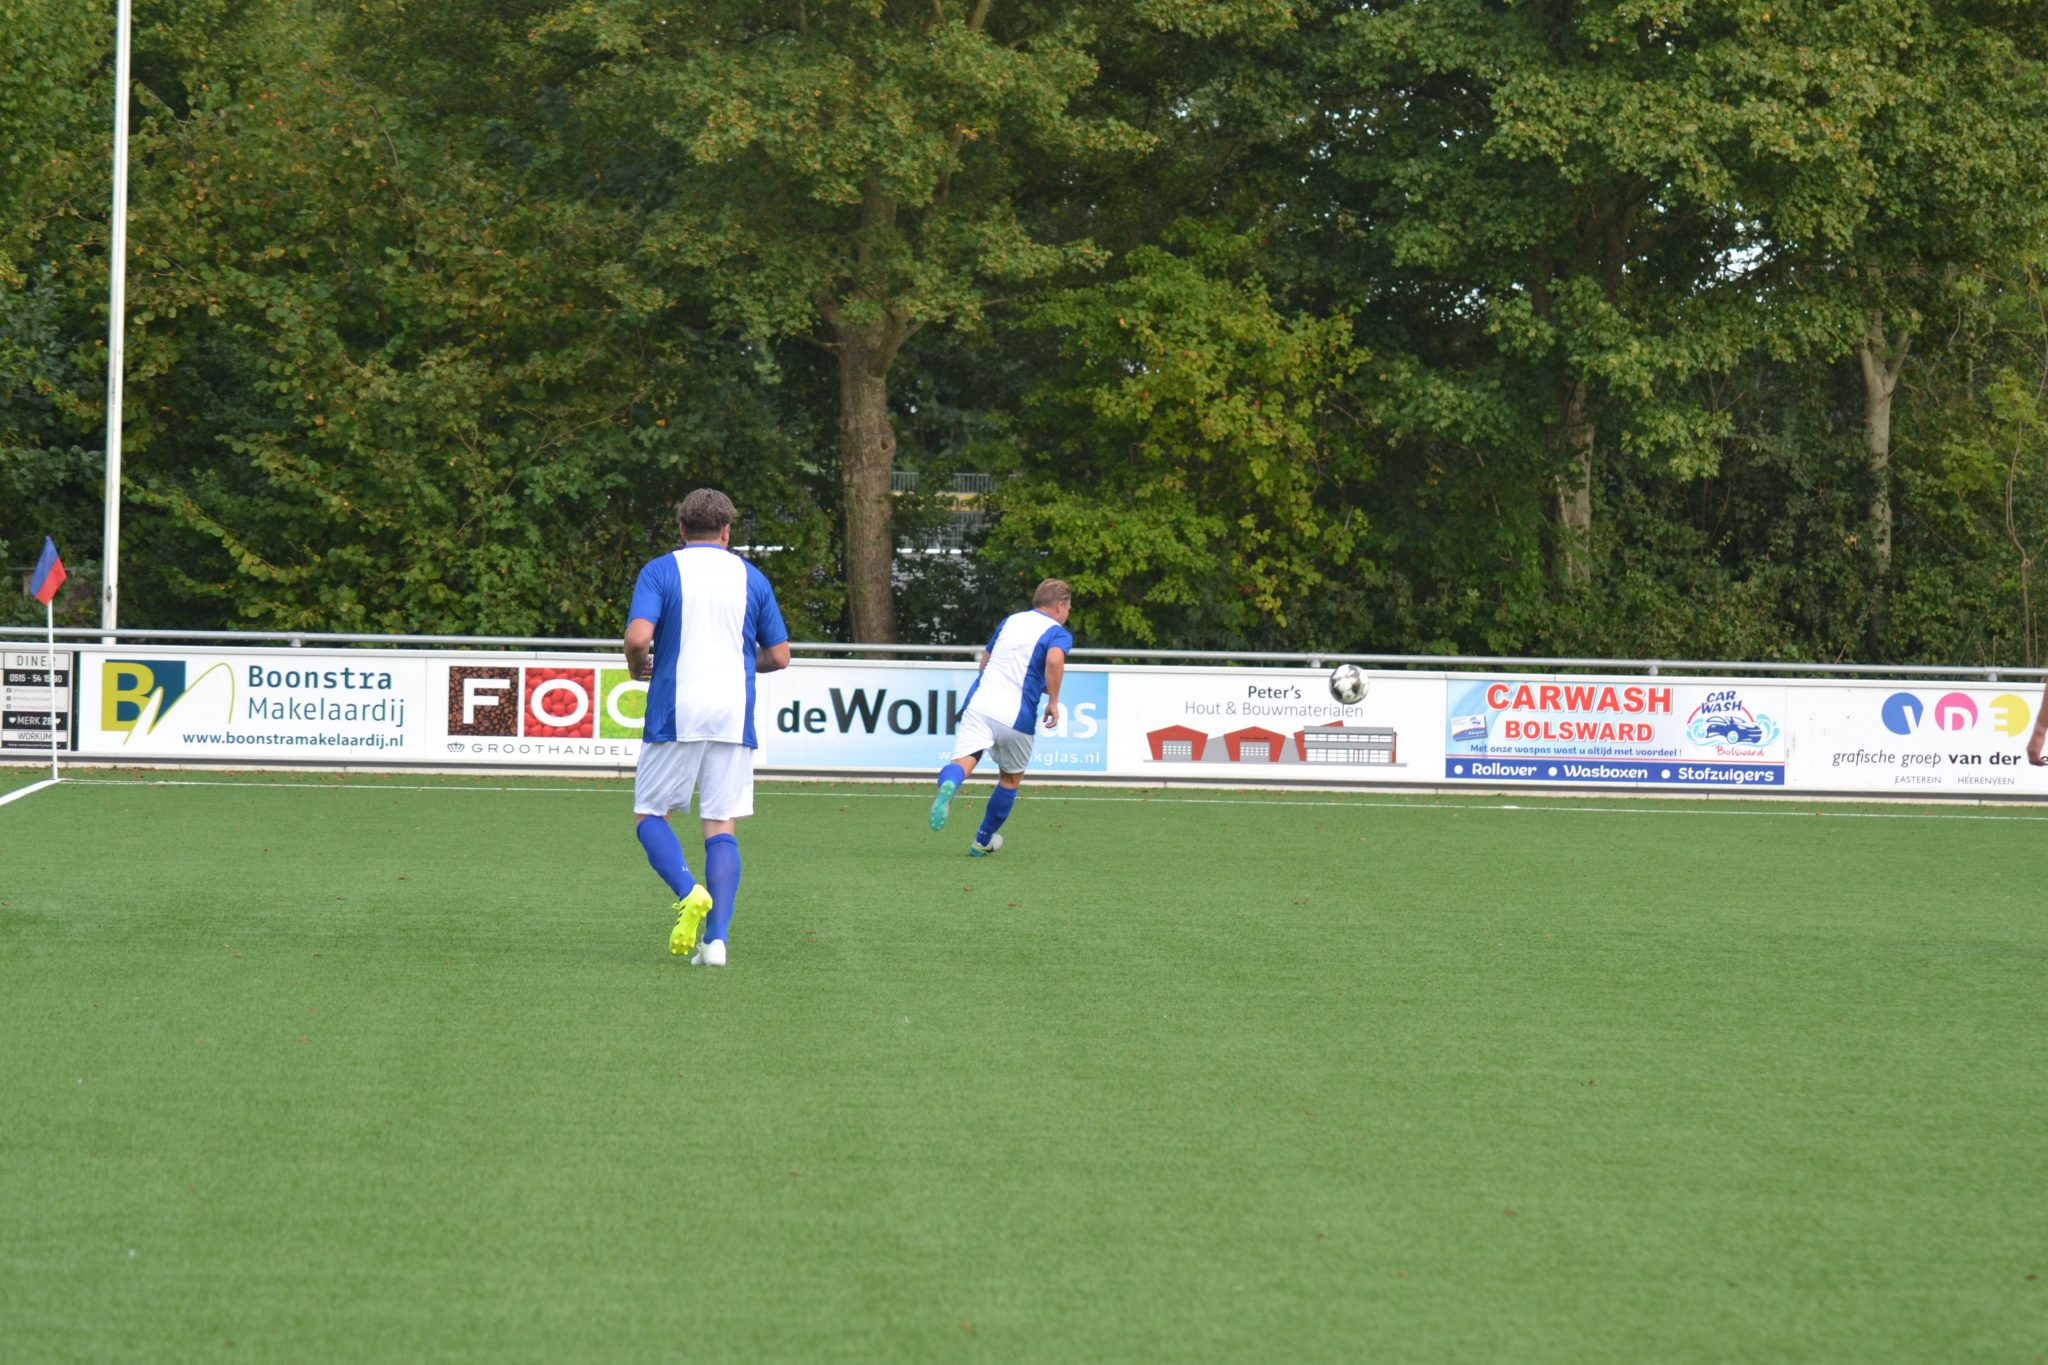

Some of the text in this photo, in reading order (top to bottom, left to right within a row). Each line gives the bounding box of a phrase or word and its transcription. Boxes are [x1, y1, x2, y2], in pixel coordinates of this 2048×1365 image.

[248, 665, 392, 690] Boonstra
[1248, 685, 1301, 700] Peter's
[1486, 684, 1673, 714] CARWASH
[1707, 691, 1736, 704] CAR
[248, 697, 405, 728] Makelaardij
[1185, 701, 1363, 717] Hout & Bouwmaterialen
[1701, 700, 1742, 714] WASH
[17, 716, 41, 725] MERK
[1504, 719, 1655, 744] BOLSWARD
[183, 731, 404, 749] www.boonstramakelaardij.nl
[472, 743, 633, 756] GROOTHANDEL
[1471, 744, 1489, 754] Met
[1490, 746, 1513, 754] onze
[1515, 746, 1551, 757] waspas
[1553, 746, 1577, 756] wast
[1579, 748, 1586, 756] u
[1587, 746, 1613, 758] altijd
[1614, 747, 1634, 757] met
[1635, 747, 1678, 758] voordeel
[1715, 745, 1765, 757] Bolsward
[1832, 748, 2022, 768] grafische groep van der
[1472, 762, 1775, 784] Rollover Wasboxen Stofzuigers
[1894, 776, 2015, 786] EASTEREIN HEERENVEEN
